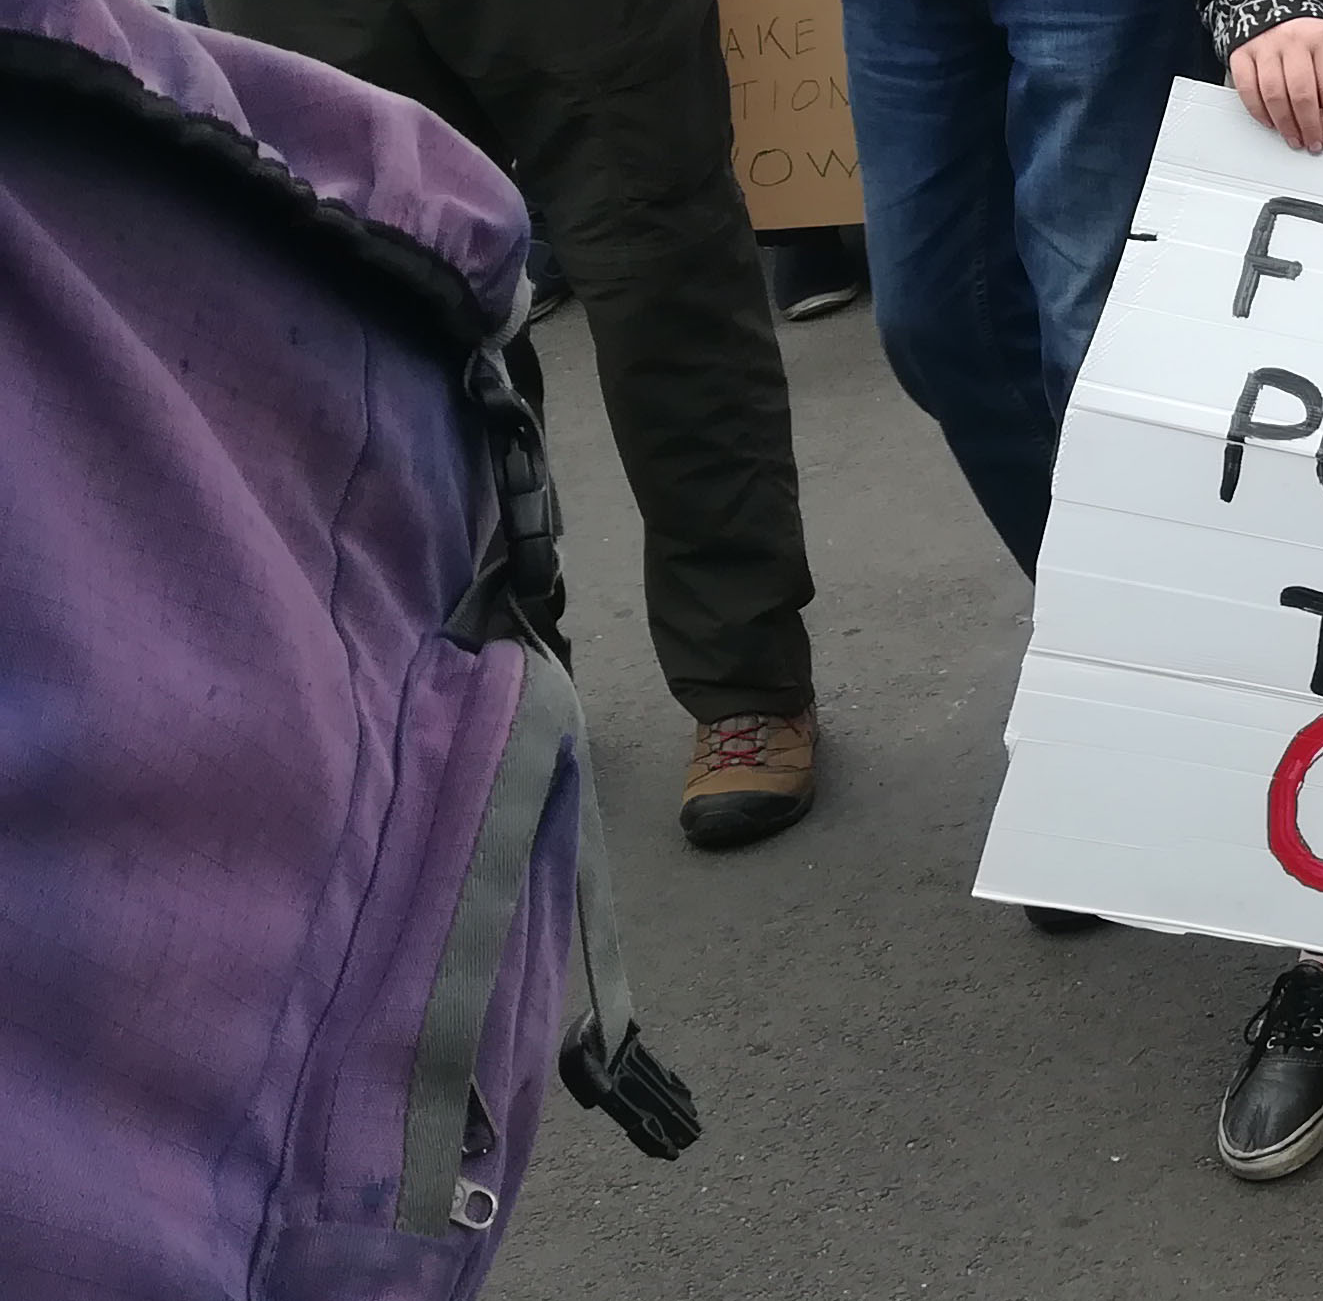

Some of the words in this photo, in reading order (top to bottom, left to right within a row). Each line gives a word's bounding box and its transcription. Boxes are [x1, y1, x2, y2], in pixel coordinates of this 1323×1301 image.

[724, 16, 817, 60] AKE
[730, 76, 850, 120] TION
[733, 148, 858, 187] OW
